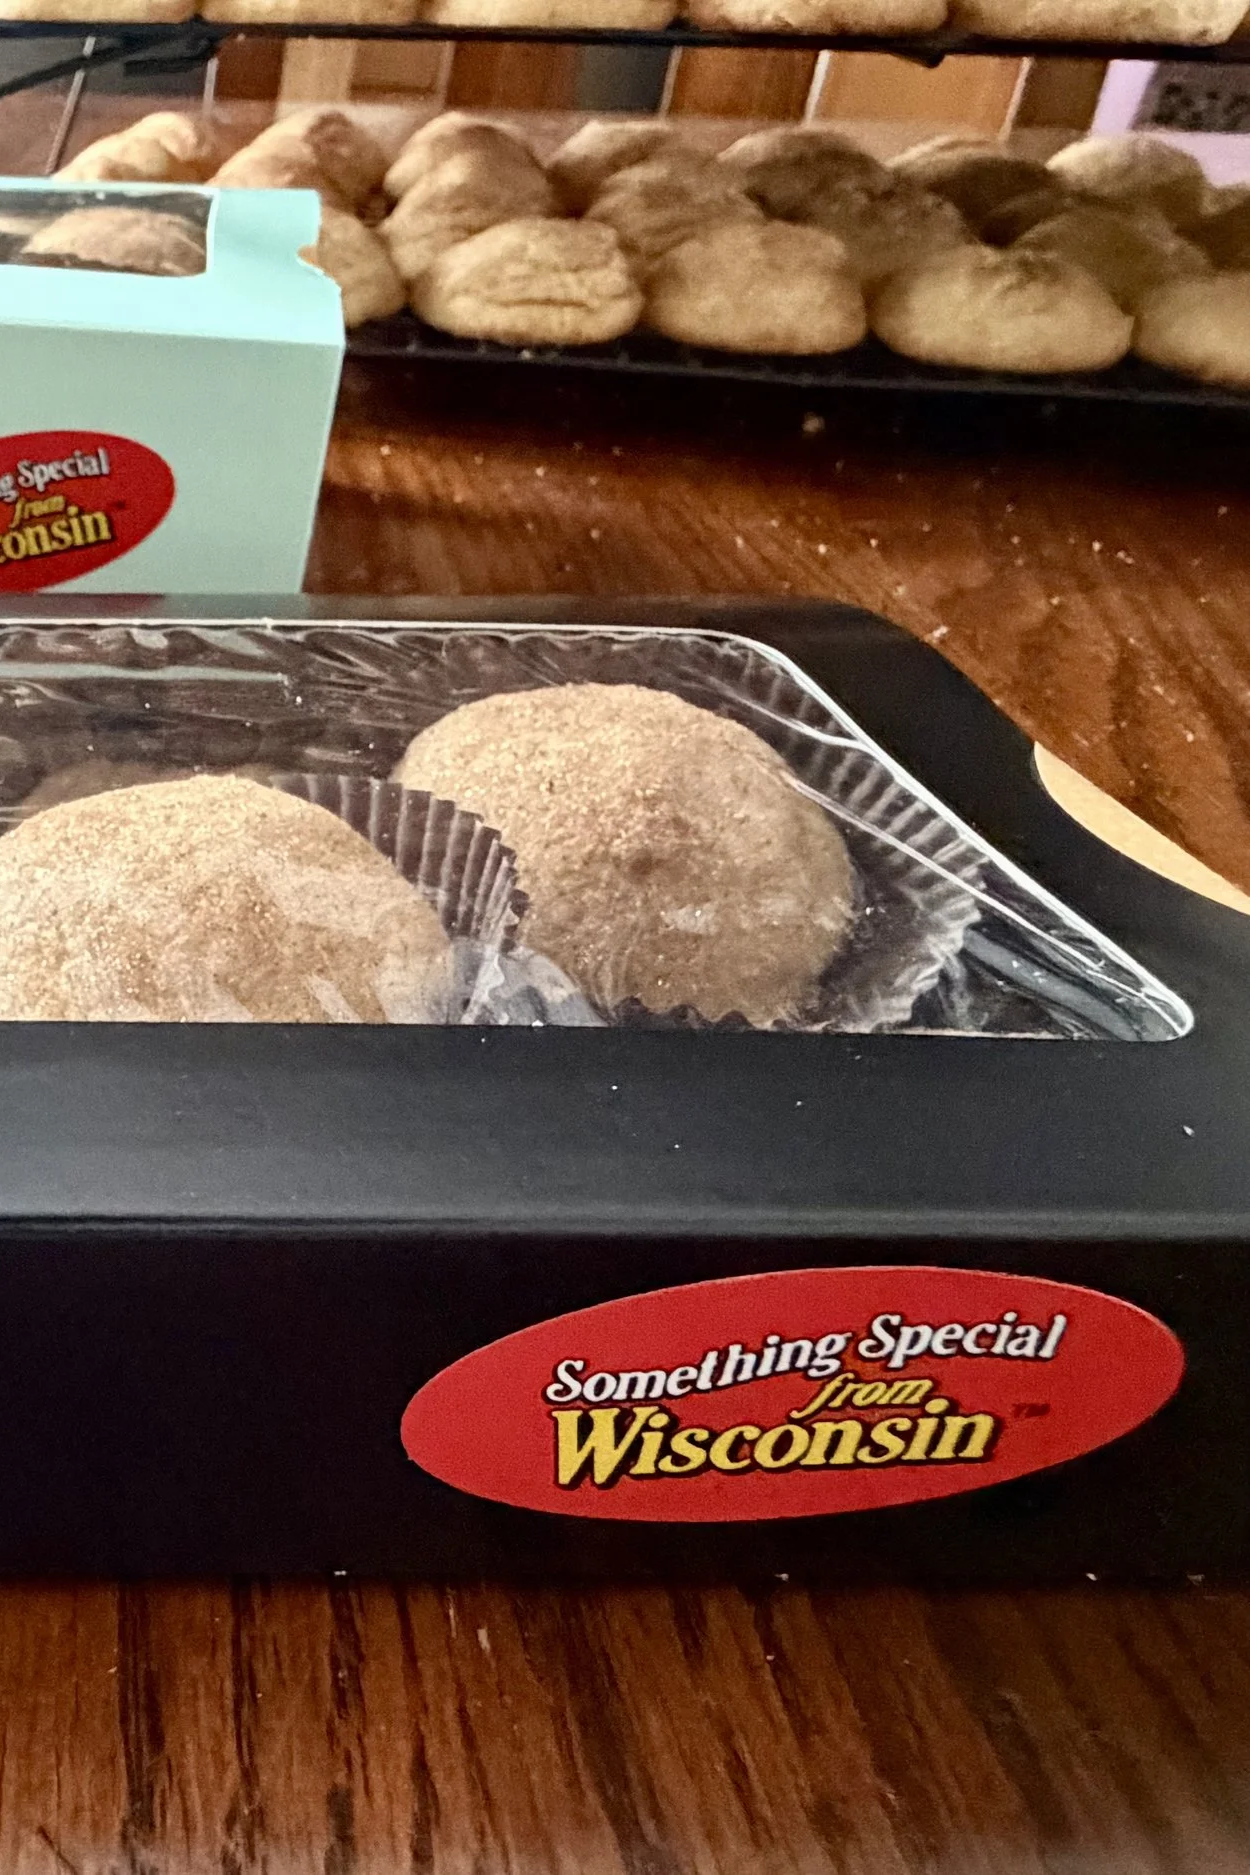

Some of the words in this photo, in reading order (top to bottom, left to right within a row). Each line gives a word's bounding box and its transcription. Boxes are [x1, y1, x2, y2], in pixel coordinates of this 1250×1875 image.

[17, 447, 111, 492] Special
[8, 495, 66, 529] from
[546, 1332, 853, 1402] Something
[857, 1312, 1068, 1369] Special
[789, 1373, 934, 1420] from
[551, 1398, 996, 1486] Wisconsin
